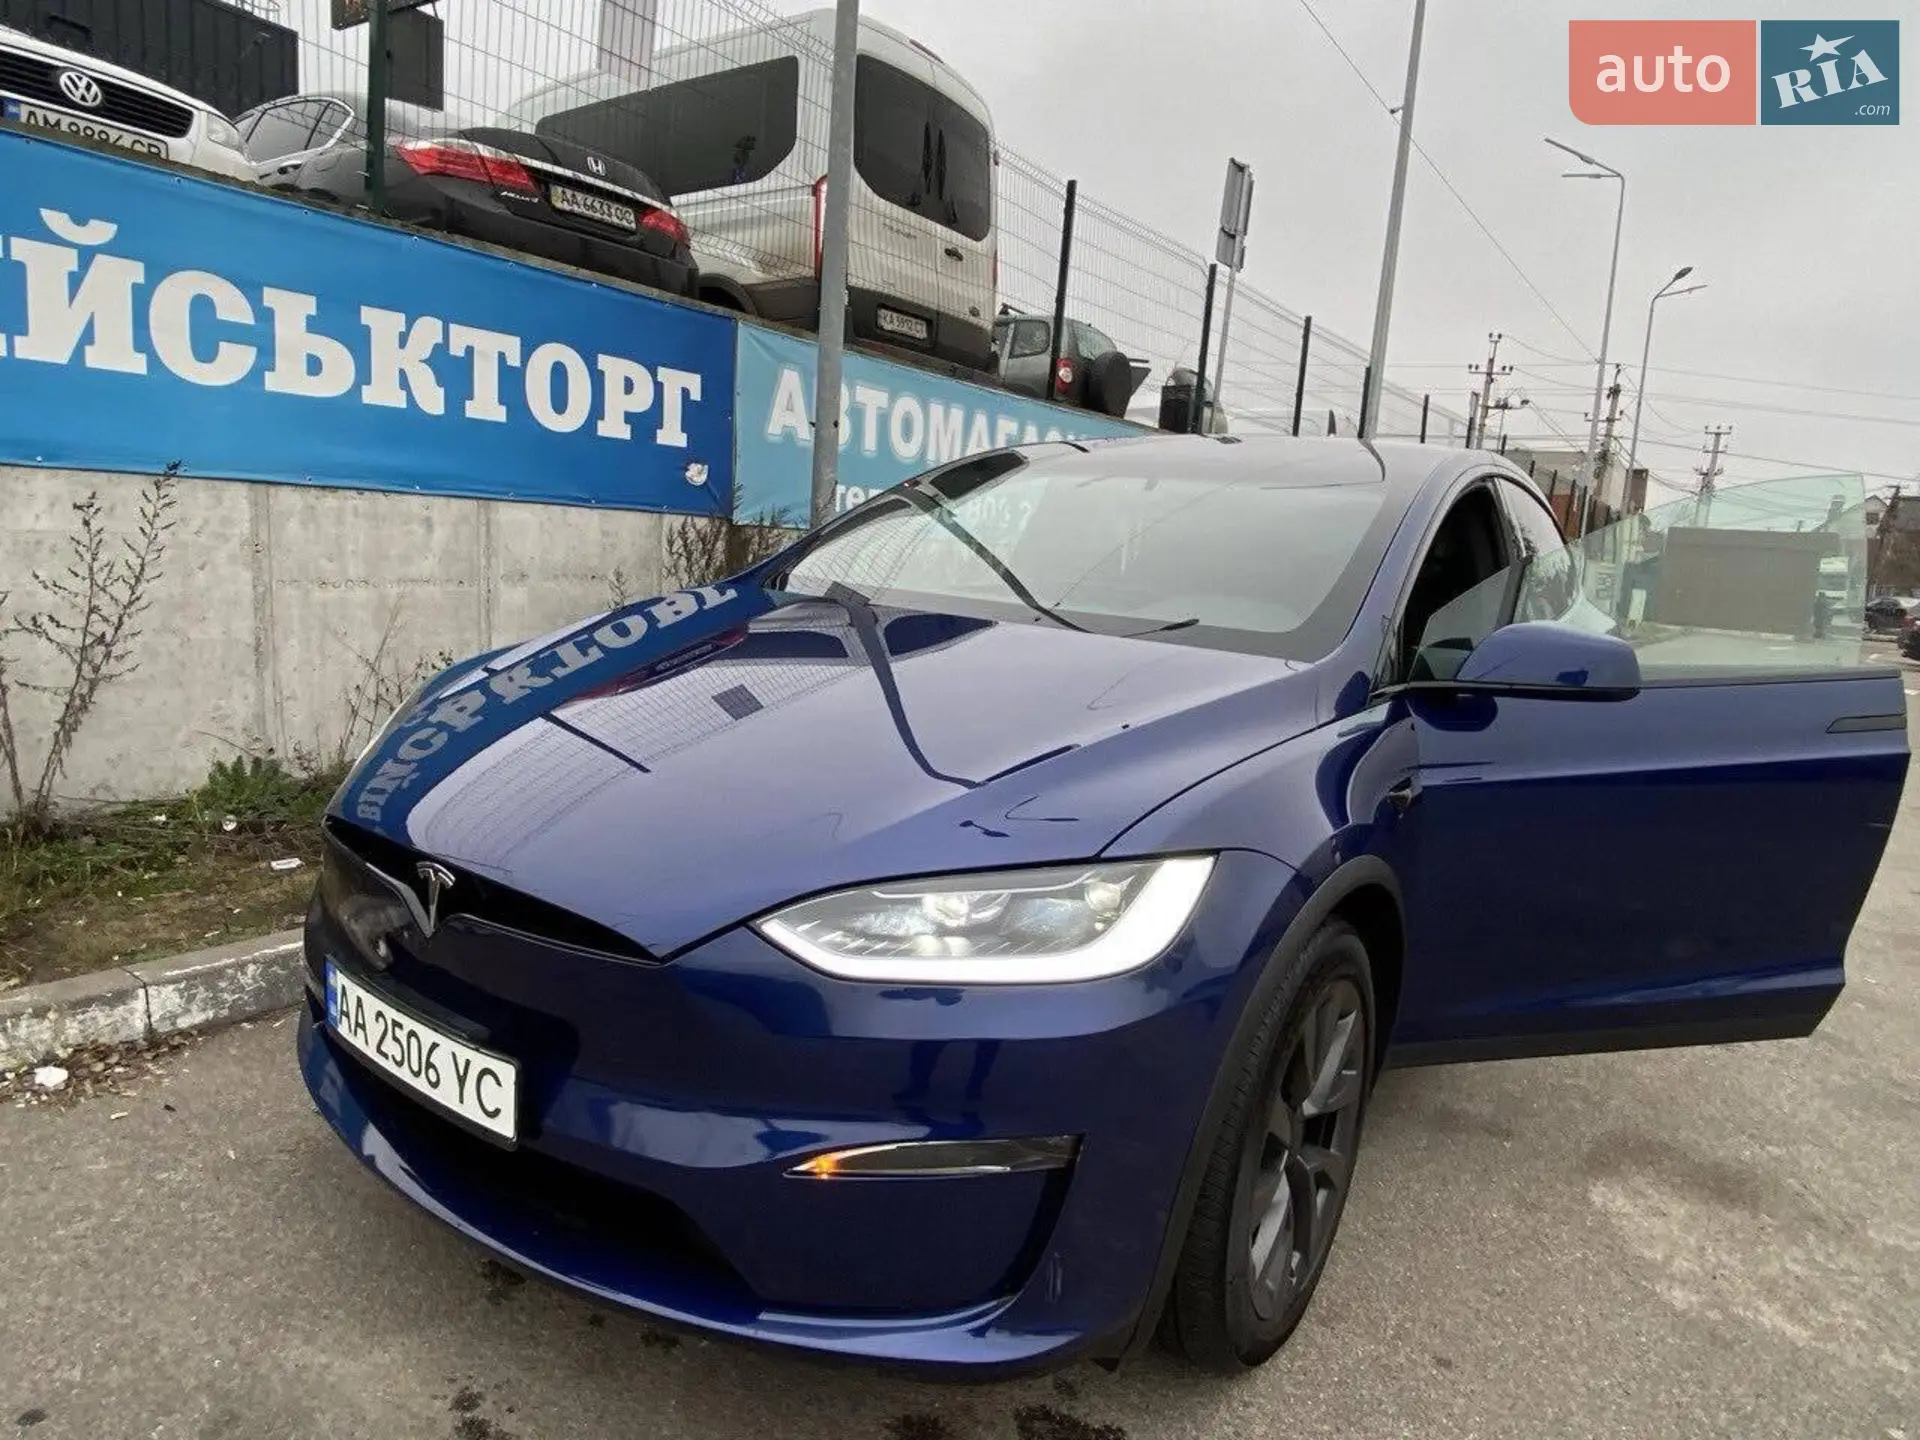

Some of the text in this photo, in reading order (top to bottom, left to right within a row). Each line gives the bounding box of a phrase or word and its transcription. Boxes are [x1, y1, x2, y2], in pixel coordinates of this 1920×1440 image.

[0, 207, 702, 449] ЙСЬКТОРГ
[835, 484, 884, 513] те
[338, 983, 369, 1047] AA
[374, 1010, 442, 1091] 2506
[451, 1051, 503, 1120] YC
